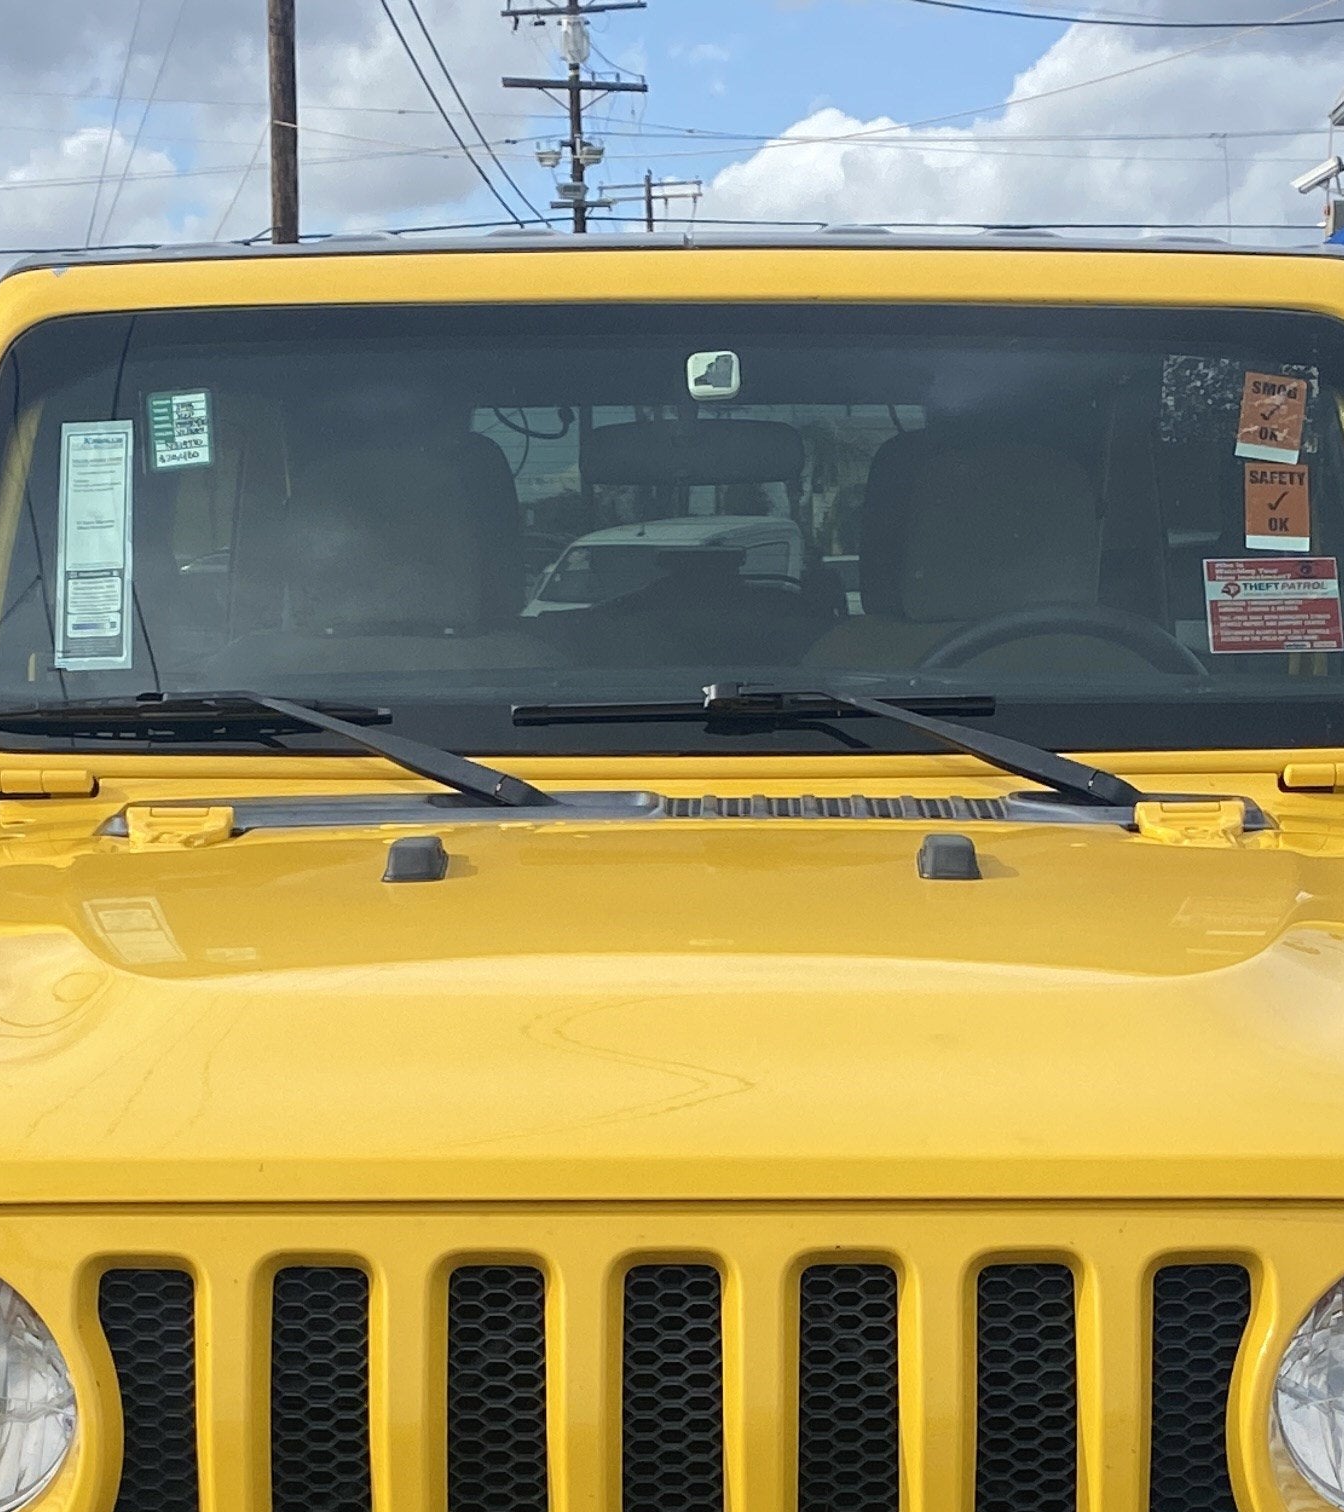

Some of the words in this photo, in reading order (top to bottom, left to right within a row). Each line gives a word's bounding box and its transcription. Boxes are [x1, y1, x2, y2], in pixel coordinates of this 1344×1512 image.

[1249, 470, 1306, 486] SAFETY
[1268, 517, 1290, 532] OK
[1242, 582, 1280, 591] THEFT
[1281, 581, 1327, 590] PATROL
